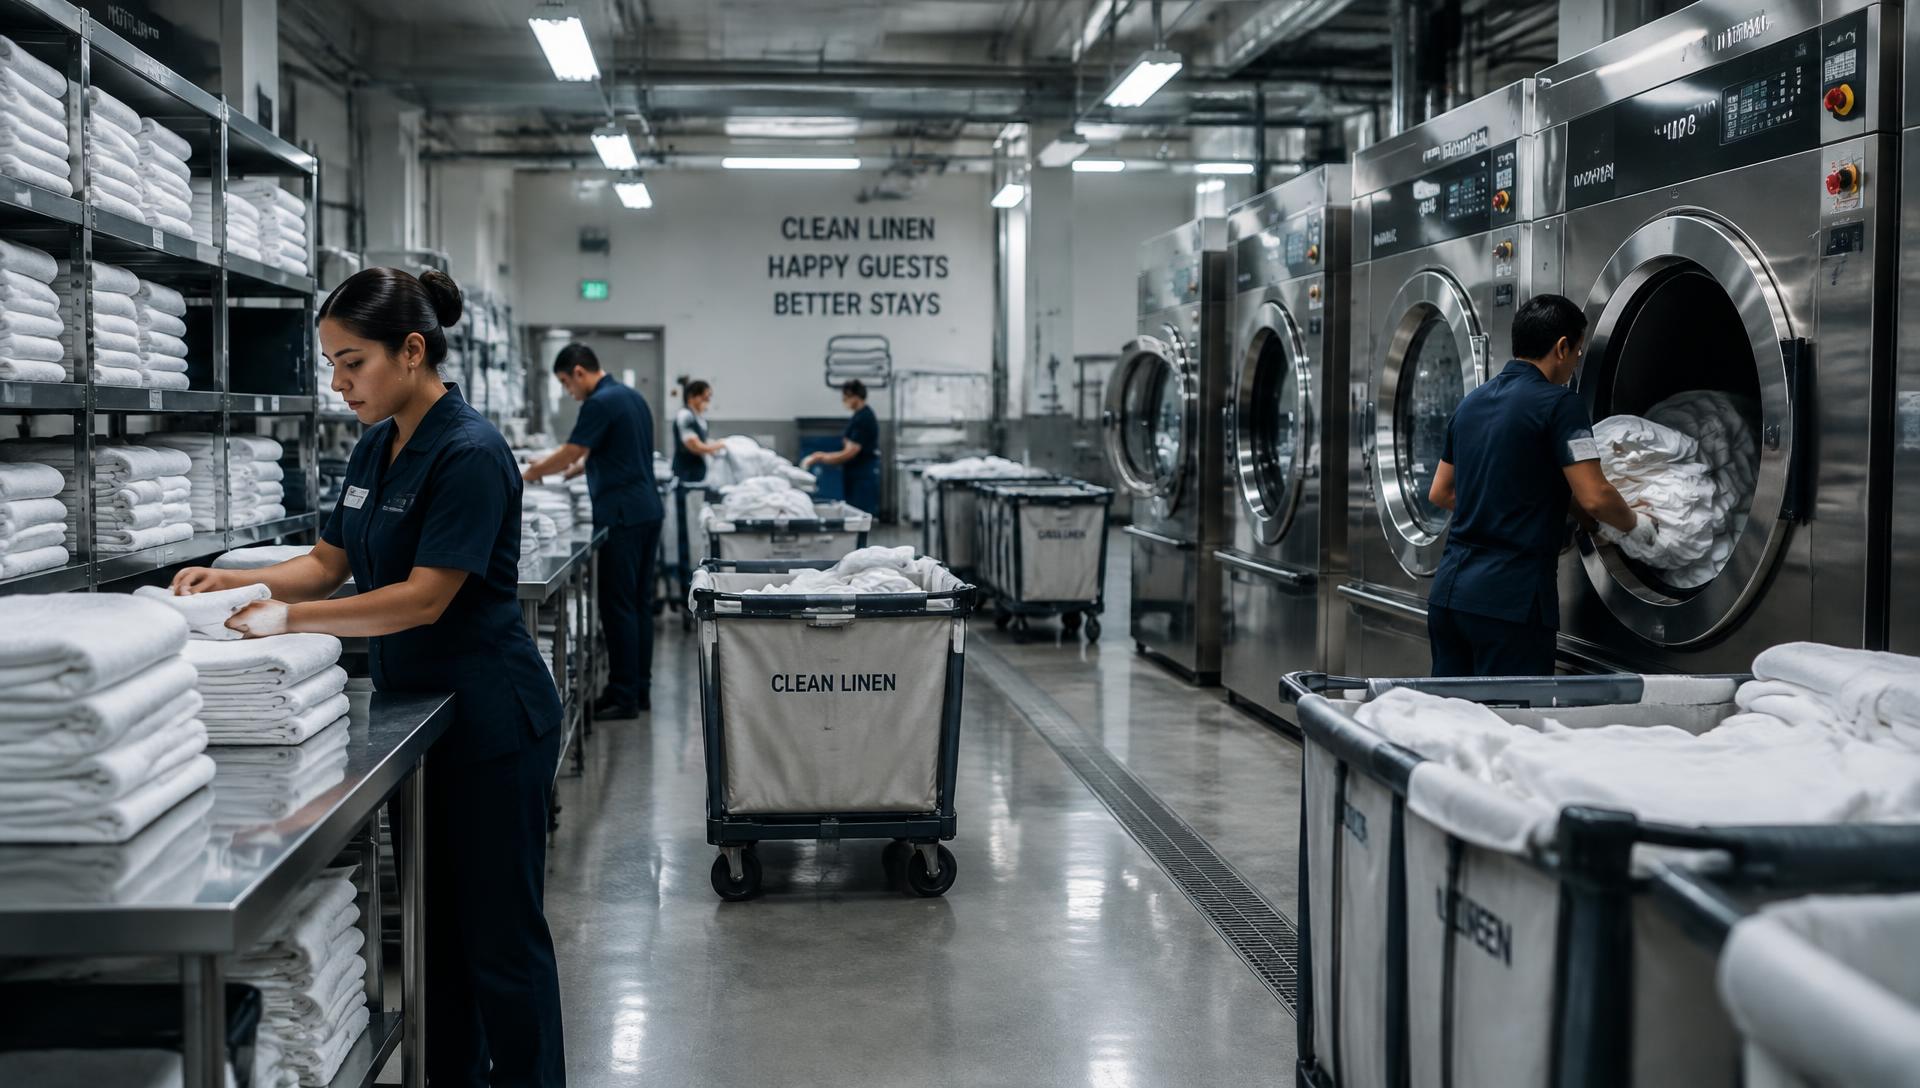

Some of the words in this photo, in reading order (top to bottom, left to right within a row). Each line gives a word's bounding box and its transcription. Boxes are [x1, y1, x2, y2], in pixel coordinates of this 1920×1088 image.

[780, 215, 859, 241] CLEAN
[867, 215, 935, 241] LINEN
[768, 253, 849, 279] HAPPY
[857, 253, 948, 279] GUESTS
[774, 292, 861, 315] BETTER
[869, 292, 940, 315] STAYS
[771, 673, 833, 692] CLEAN
[841, 673, 897, 692] LINEN
